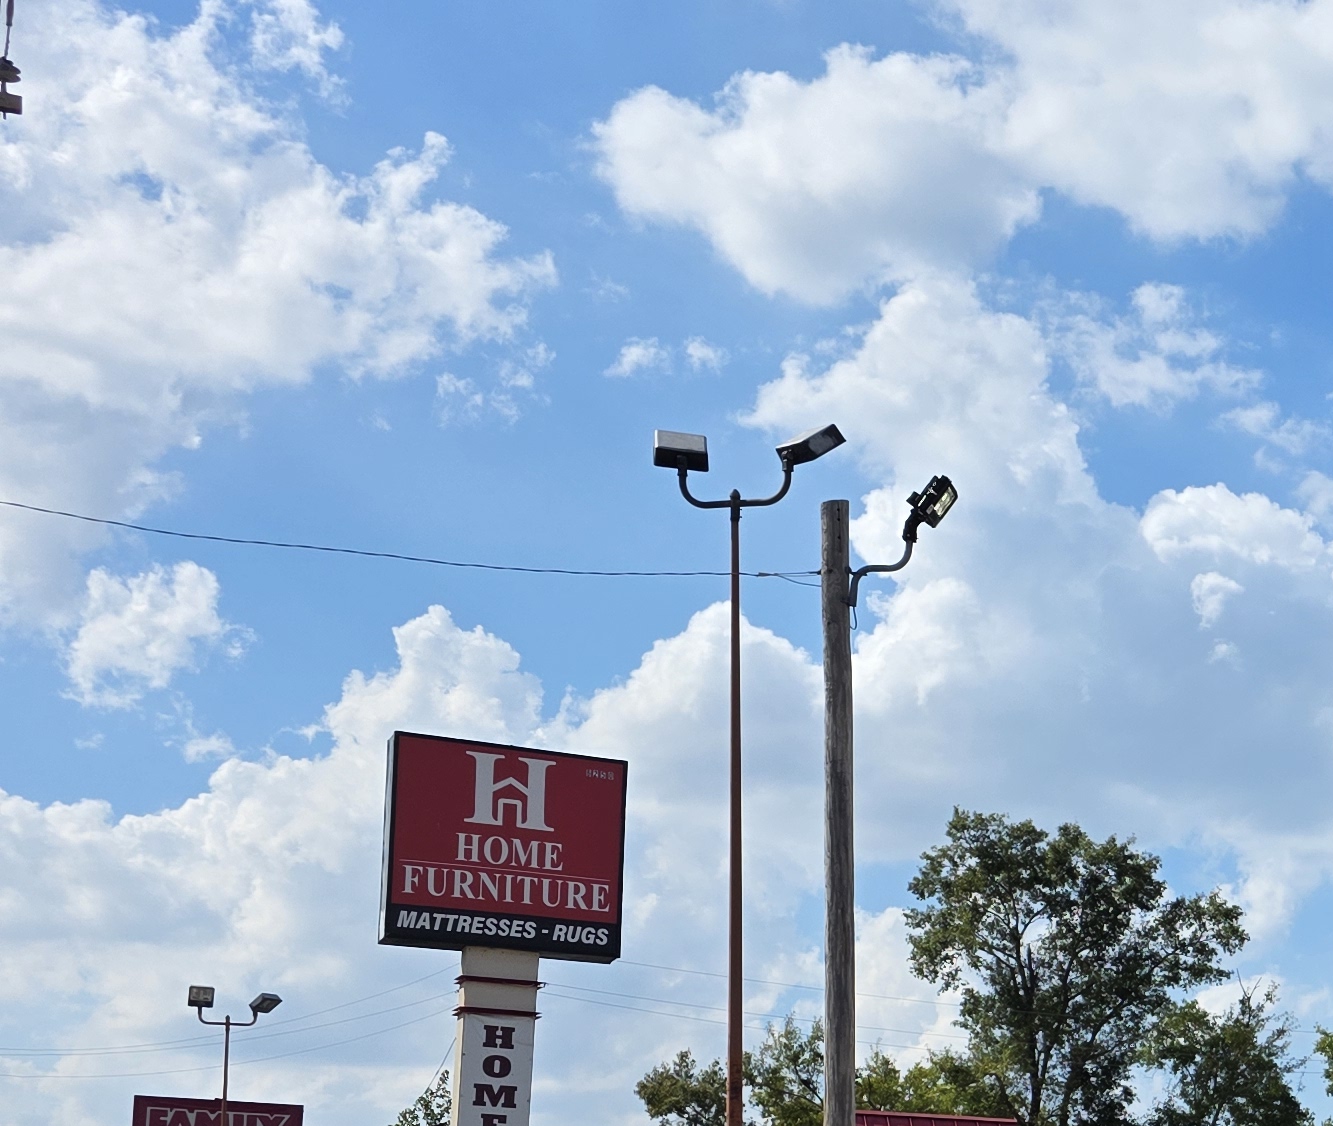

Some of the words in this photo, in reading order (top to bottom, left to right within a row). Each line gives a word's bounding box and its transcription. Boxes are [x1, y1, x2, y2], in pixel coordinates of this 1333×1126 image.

[455, 832, 563, 871] HOME
[402, 864, 610, 912] FURNITURE
[397, 910, 537, 939] MATTRESSES
[552, 924, 610, 946] RUGS
